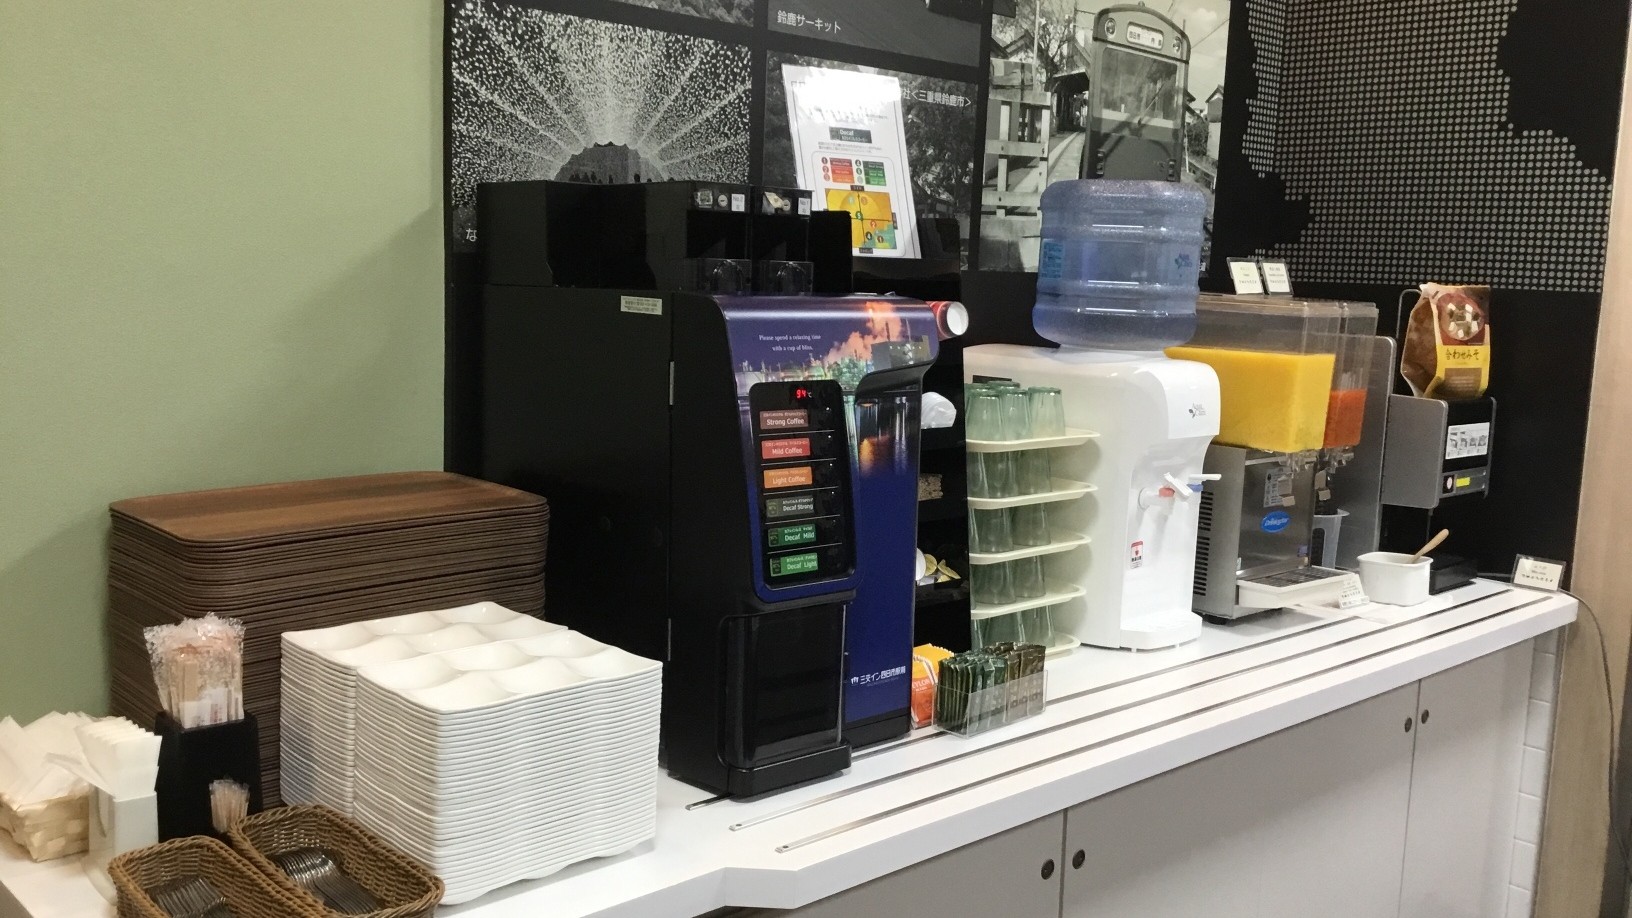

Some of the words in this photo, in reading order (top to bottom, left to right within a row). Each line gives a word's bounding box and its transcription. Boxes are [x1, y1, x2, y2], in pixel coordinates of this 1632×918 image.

[777, 10, 841, 34] 鈴鹿サーキット
[1445, 348, 1480, 360] 合わせみそ
[772, 477, 787, 486] Light
[783, 504, 796, 512] Decaf
